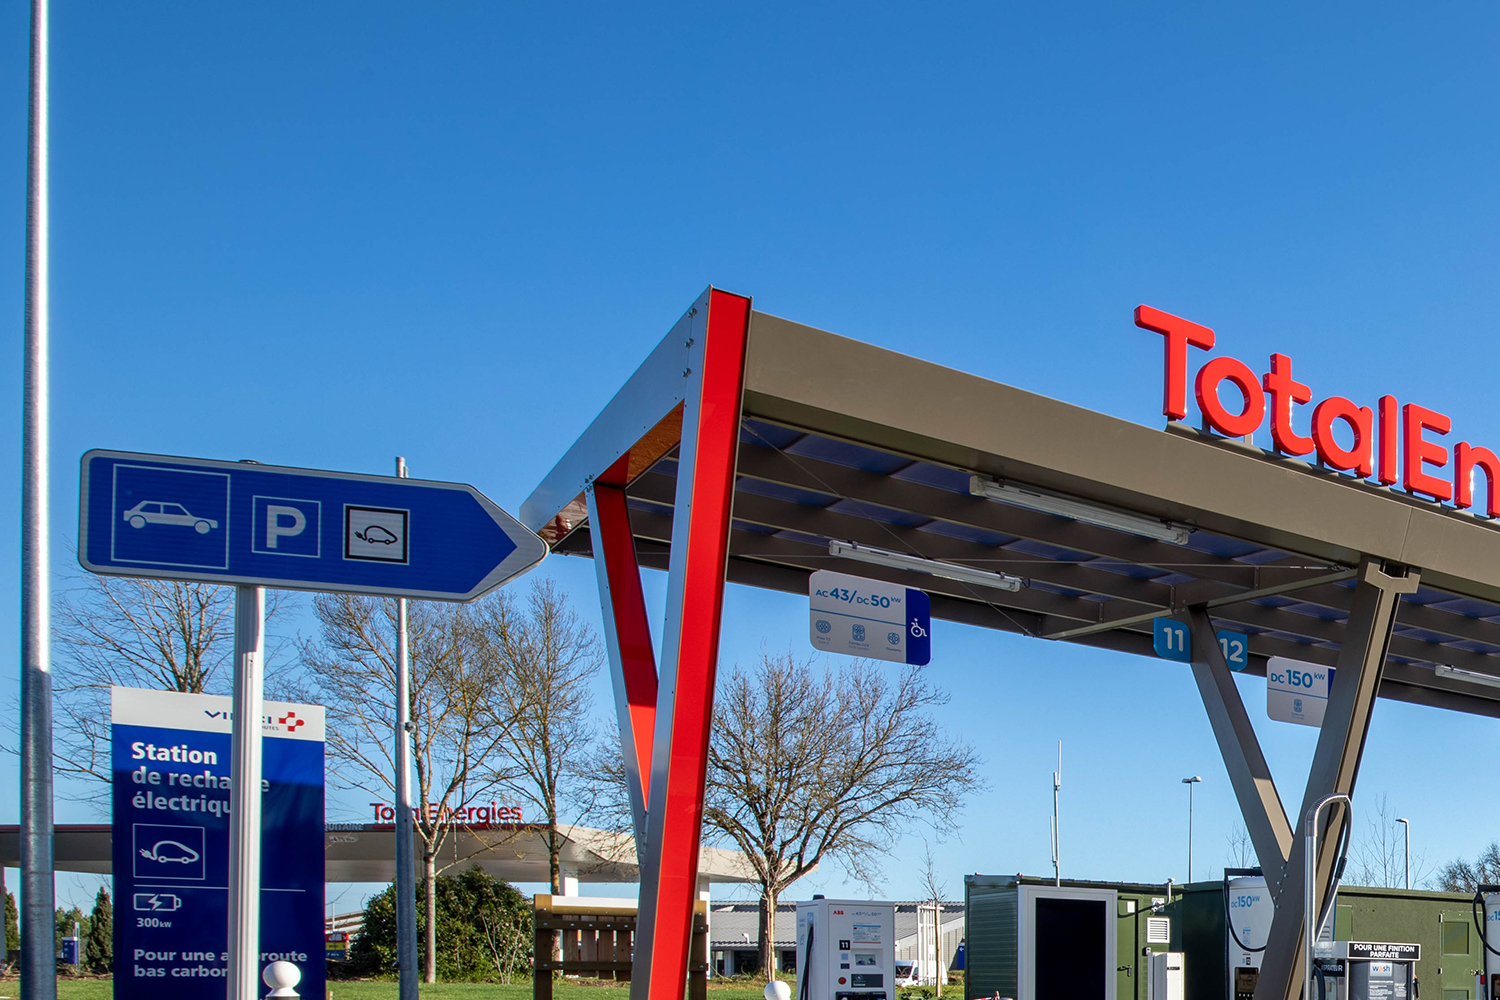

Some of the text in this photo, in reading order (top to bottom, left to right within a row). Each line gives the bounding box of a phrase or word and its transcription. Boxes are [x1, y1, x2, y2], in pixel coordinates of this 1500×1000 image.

[266, 504, 307, 549] P
[1163, 627, 1184, 652] 11
[1219, 638, 1244, 663] 12
[1270, 672, 1285, 684] DC
[1285, 669, 1313, 689] 150
[131, 741, 218, 765] Station
[132, 766, 271, 793] de rechae
[132, 791, 232, 818] électriqu
[1237, 895, 1253, 908] 150
[841, 941, 849, 949] 11
[1388, 945, 1415, 953] FINITION
[134, 949, 308, 962] Pour une aroute
[1369, 951, 1400, 959] PARFAITE
[134, 964, 166, 977] bas
[1372, 964, 1391, 972] wash
